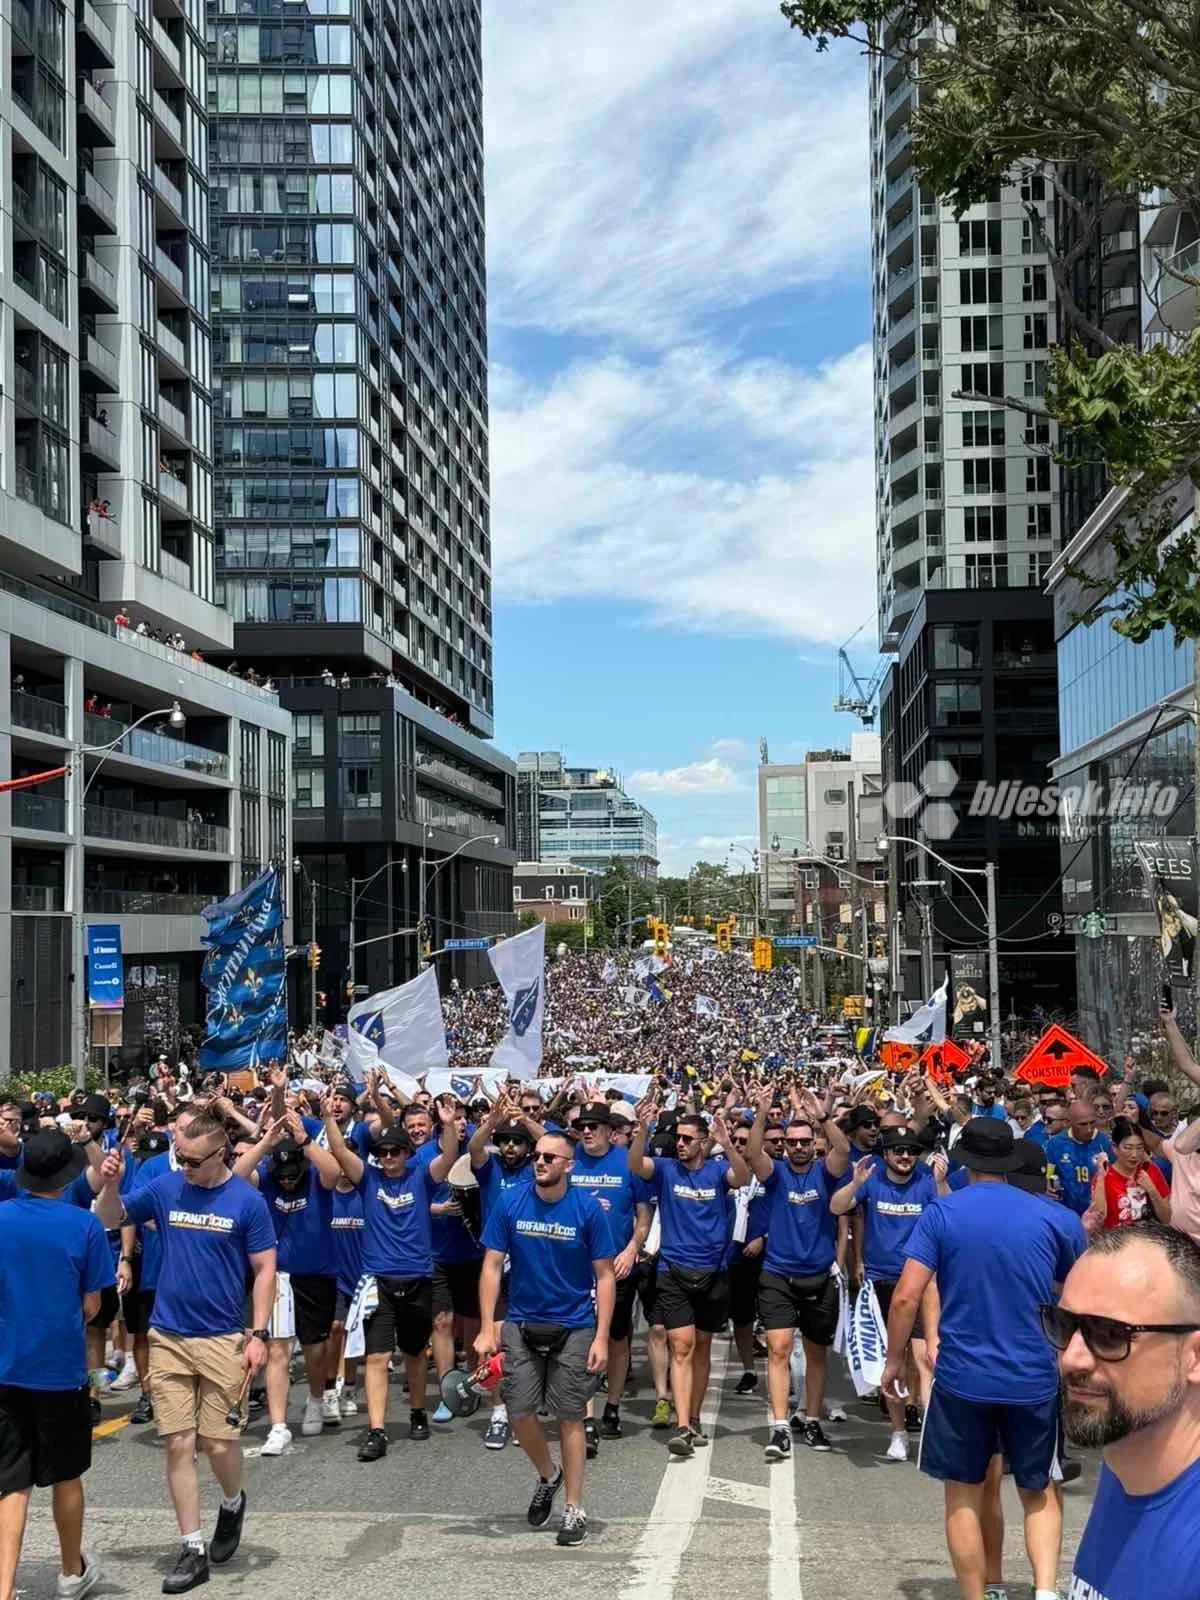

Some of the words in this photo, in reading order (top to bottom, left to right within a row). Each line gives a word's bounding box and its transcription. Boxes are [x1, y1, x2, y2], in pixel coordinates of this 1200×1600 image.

[1026, 1063, 1097, 1079] CONSTRU
[1075, 1166, 1089, 1182] 19
[516, 1220, 577, 1237] BHFANATICOS
